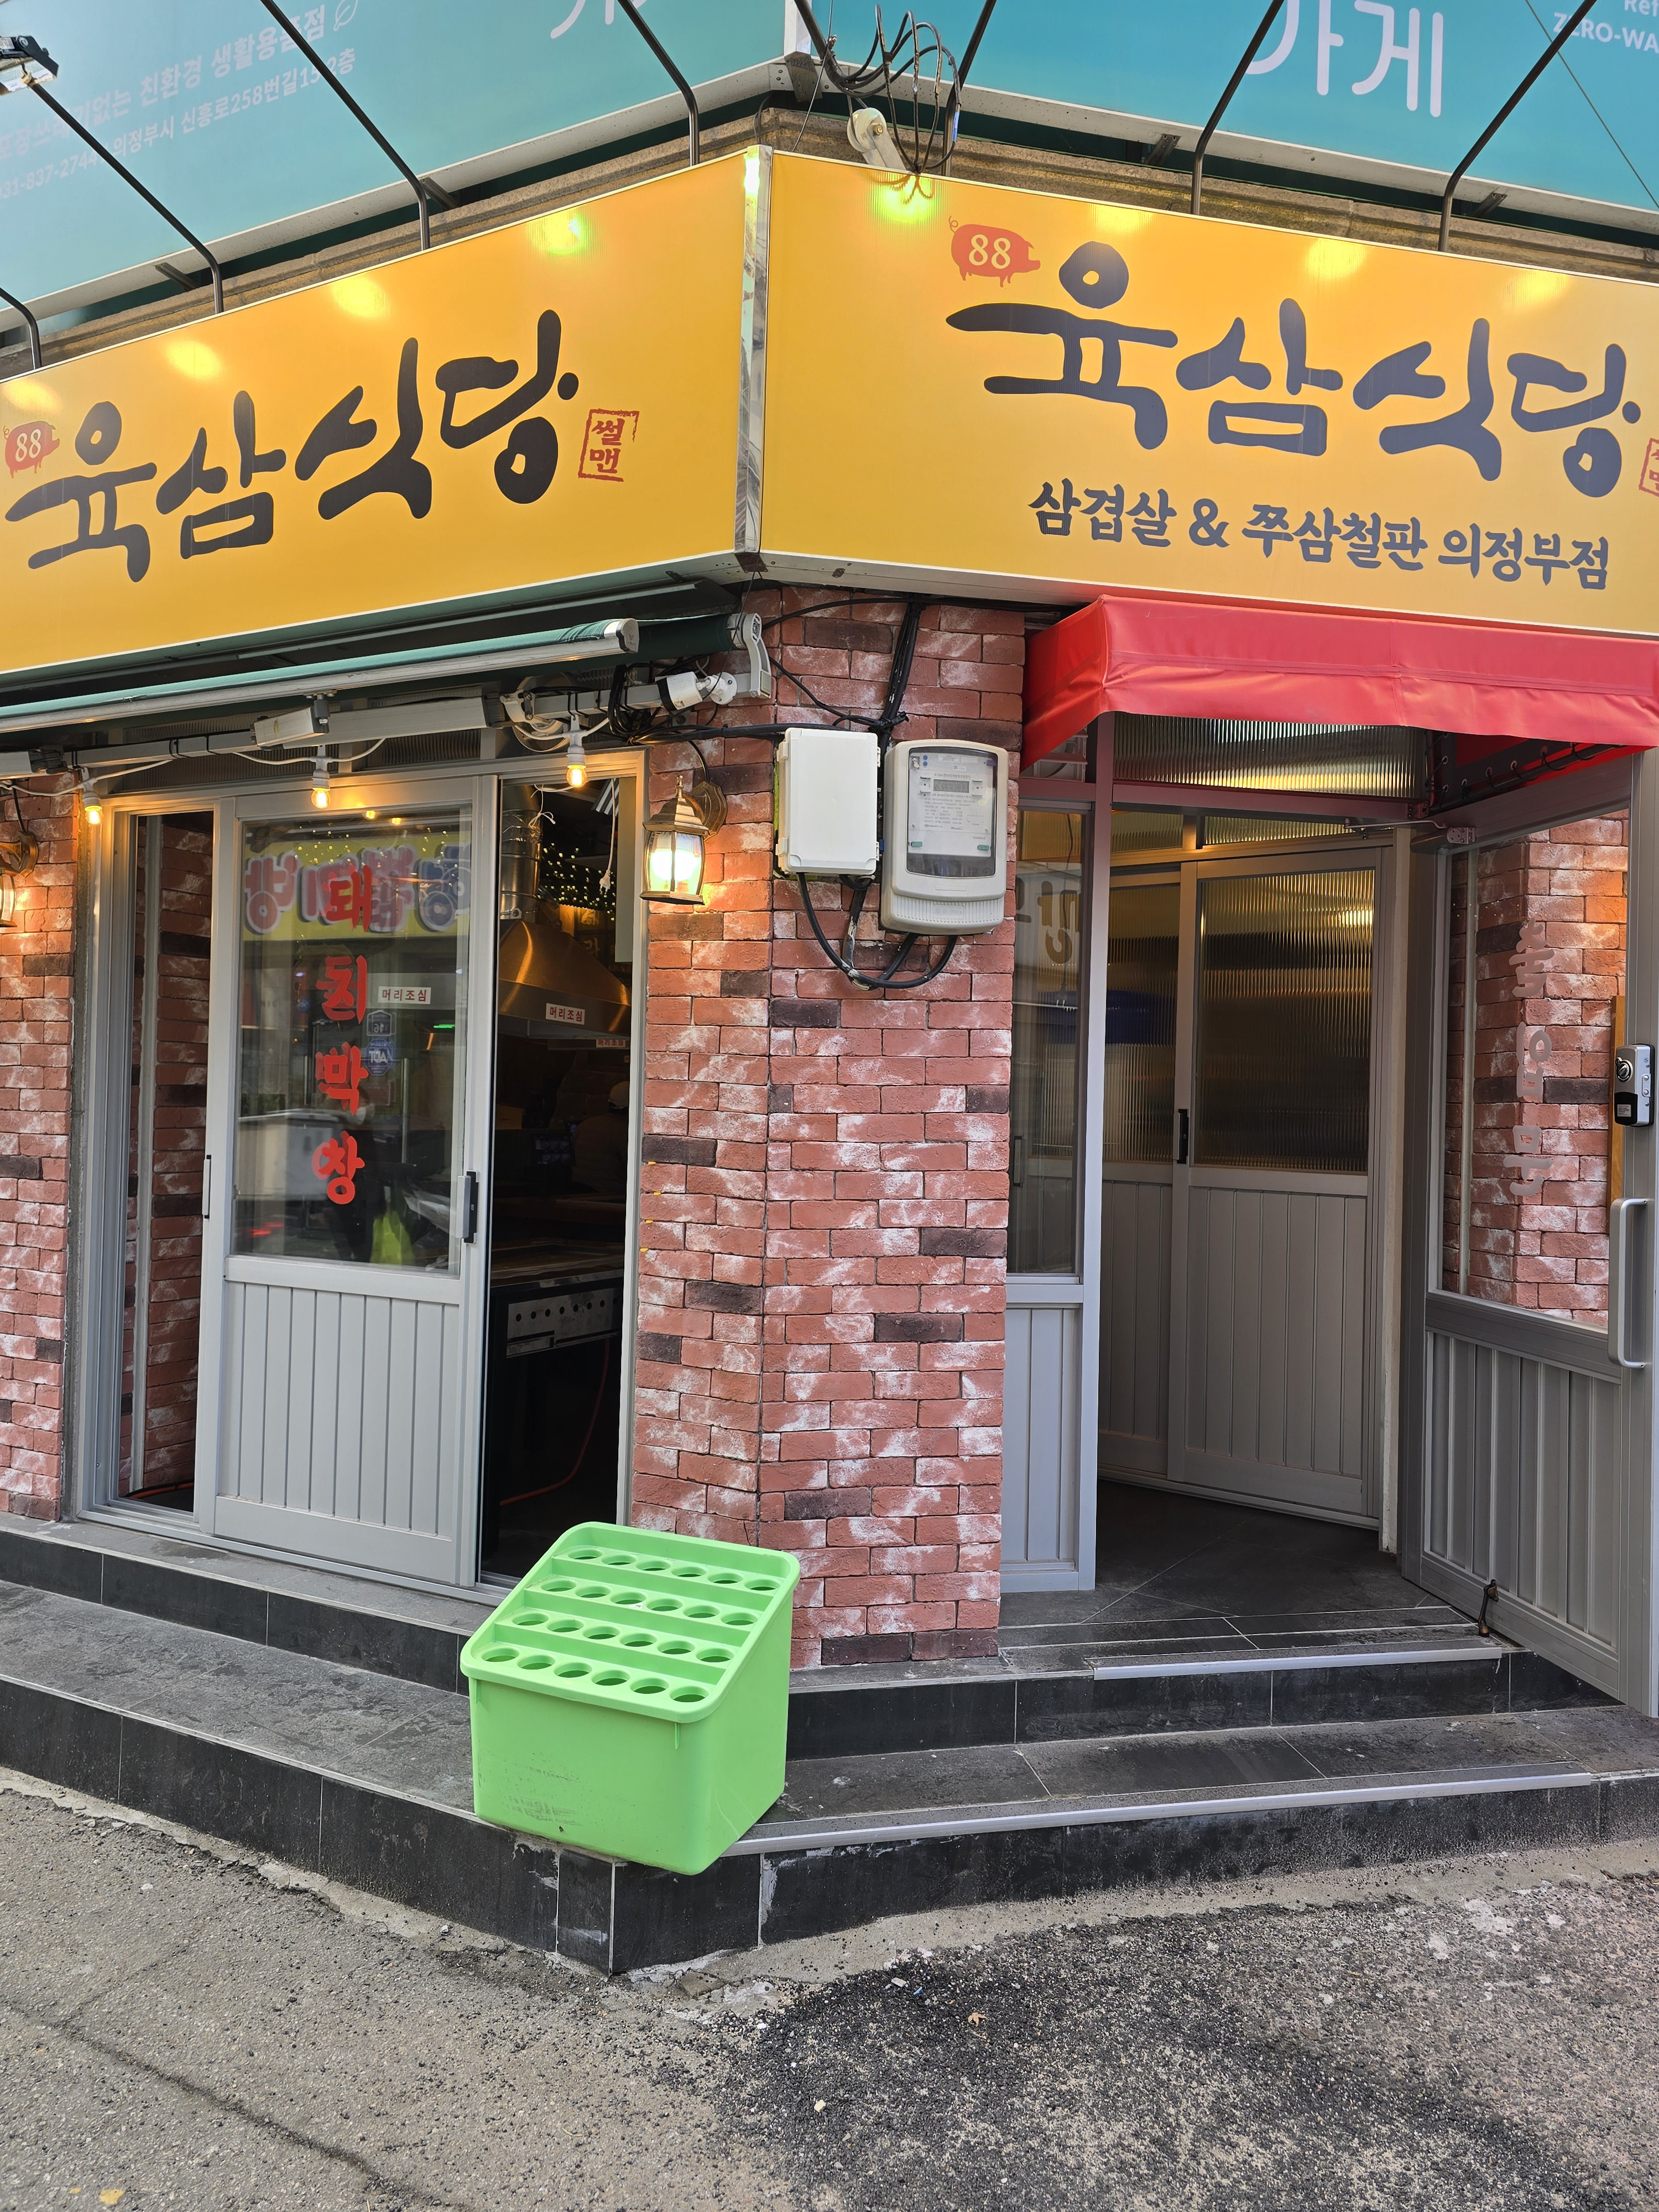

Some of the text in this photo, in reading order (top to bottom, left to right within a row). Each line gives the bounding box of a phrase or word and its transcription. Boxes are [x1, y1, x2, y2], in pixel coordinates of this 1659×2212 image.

[140, 55, 202, 107] 친환경
[0, 148, 98, 200] 31-837-2744
[112, 115, 174, 156] 의정부시
[969, 234, 1011, 269] 88
[946, 241, 1641, 498] 육삼식당
[5, 309, 579, 583] 육삼식당
[15, 429, 41, 462] 88
[1027, 478, 1609, 590] 삼겹살 & 쭈삼철판 의정부점
[382, 989, 427, 1001] 머리조심
[550, 1007, 582, 1022] 머리조심
